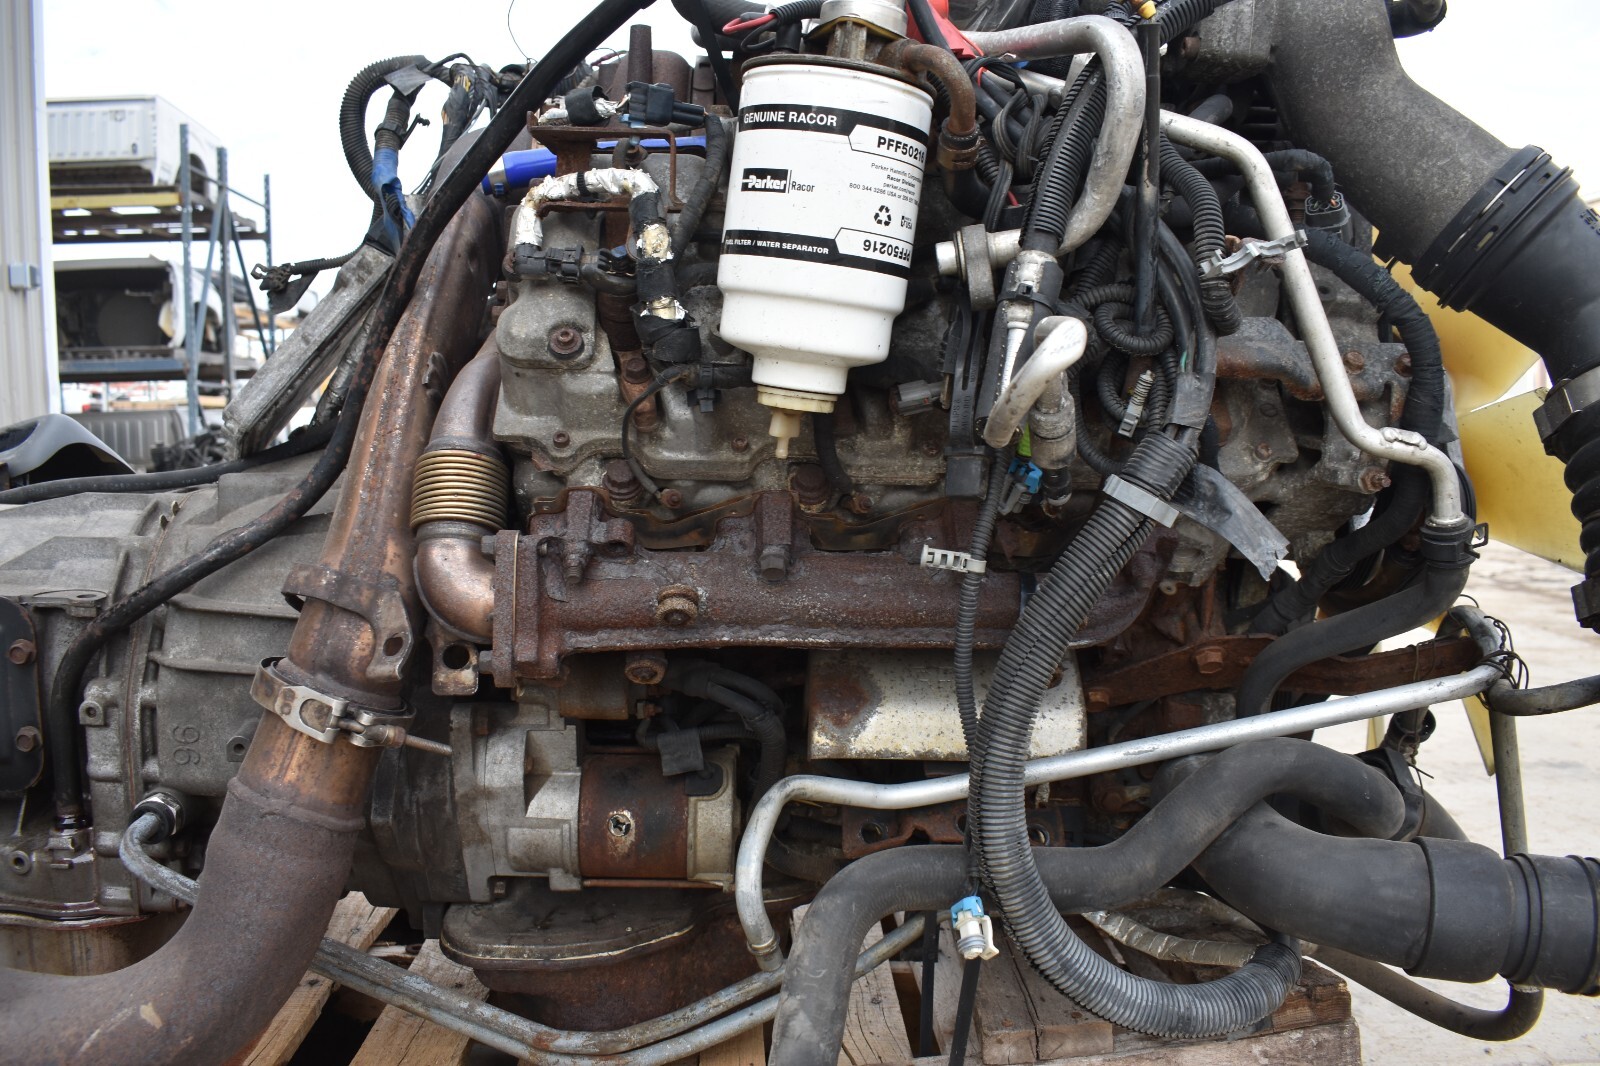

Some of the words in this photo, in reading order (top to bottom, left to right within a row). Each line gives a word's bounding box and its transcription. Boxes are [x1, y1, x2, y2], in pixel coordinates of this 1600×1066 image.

[743, 111, 786, 124] GENUINE
[788, 111, 838, 127] RACOR
[876, 135, 925, 163] PFF50216
[870, 162, 889, 172] Parker
[747, 174, 786, 190] Parker
[790, 180, 816, 193] Racor
[886, 174, 901, 183] Racor
[861, 184, 872, 192] 344
[887, 190, 897, 198] USA
[757, 240, 781, 249] WATER
[782, 242, 829, 255] SEPARATOR
